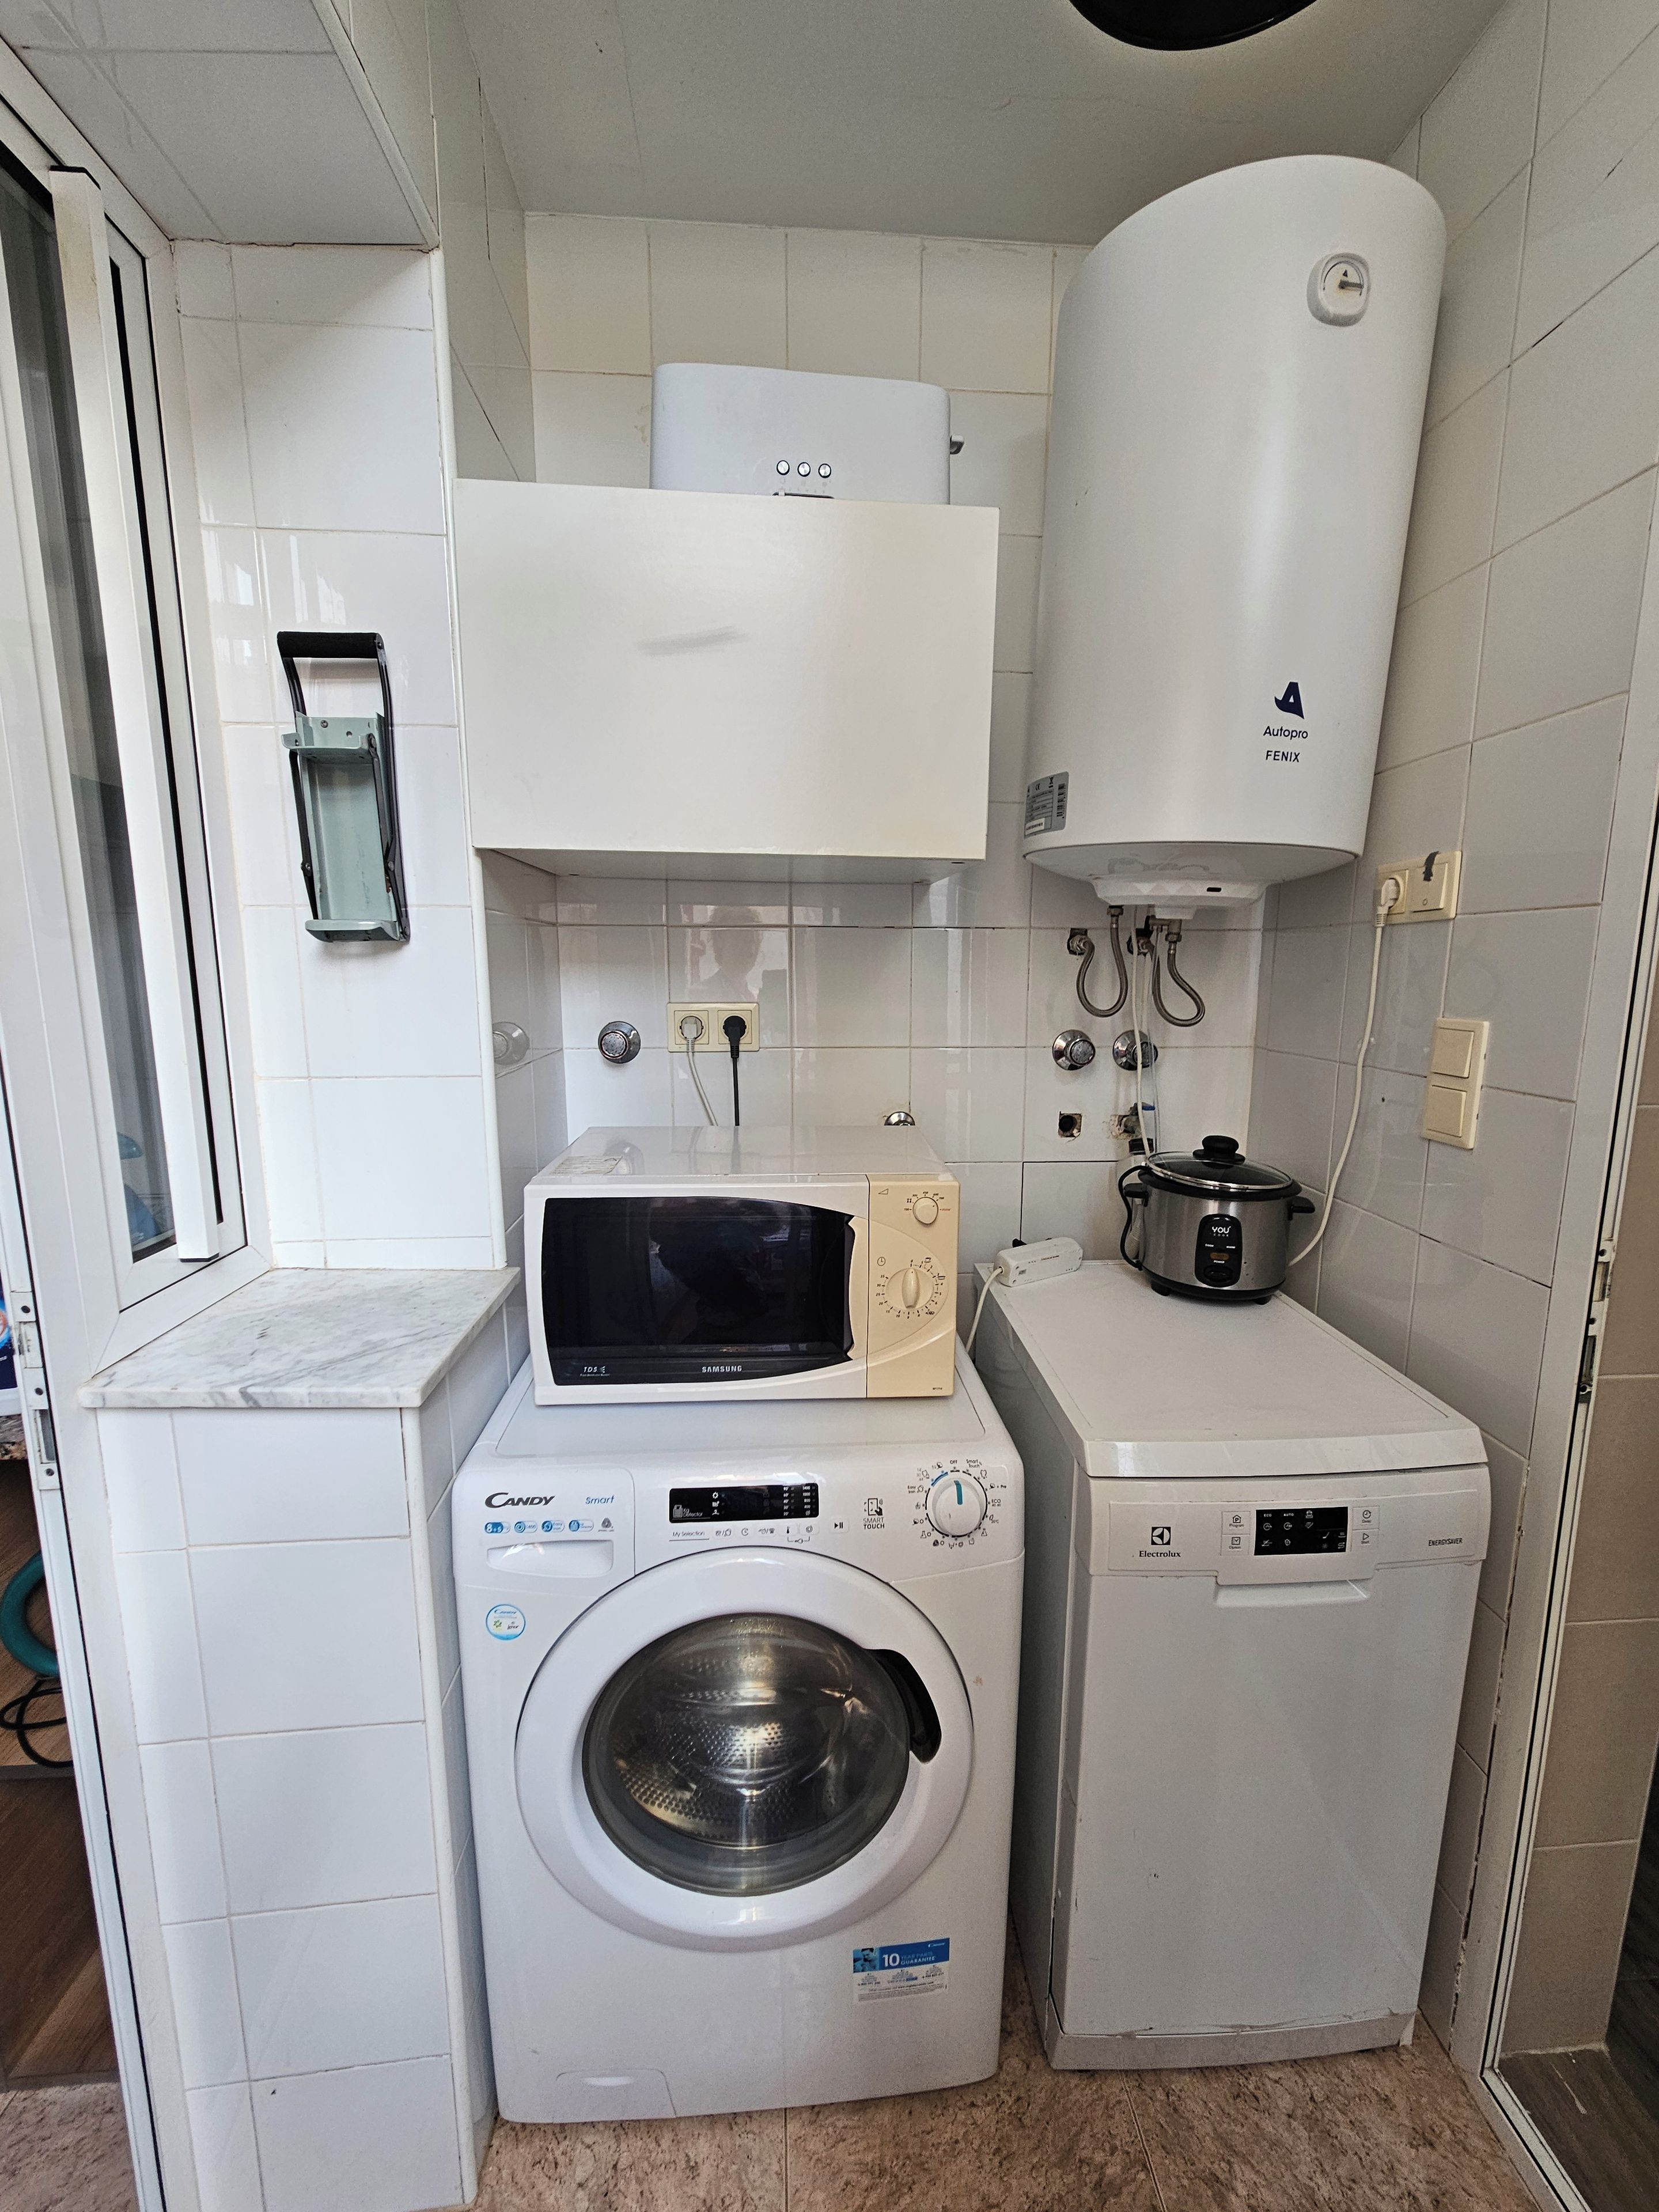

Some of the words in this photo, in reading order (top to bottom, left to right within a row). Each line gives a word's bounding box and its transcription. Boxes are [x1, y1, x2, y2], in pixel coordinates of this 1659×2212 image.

[1263, 726, 1308, 740] Autopro
[1266, 750, 1300, 762] FENIX
[1211, 1226, 1232, 1234] YOU
[585, 1495, 615, 1504] Smart
[882, 1953, 900, 1967] 10
[900, 1956, 936, 1965] GUARANTEE
